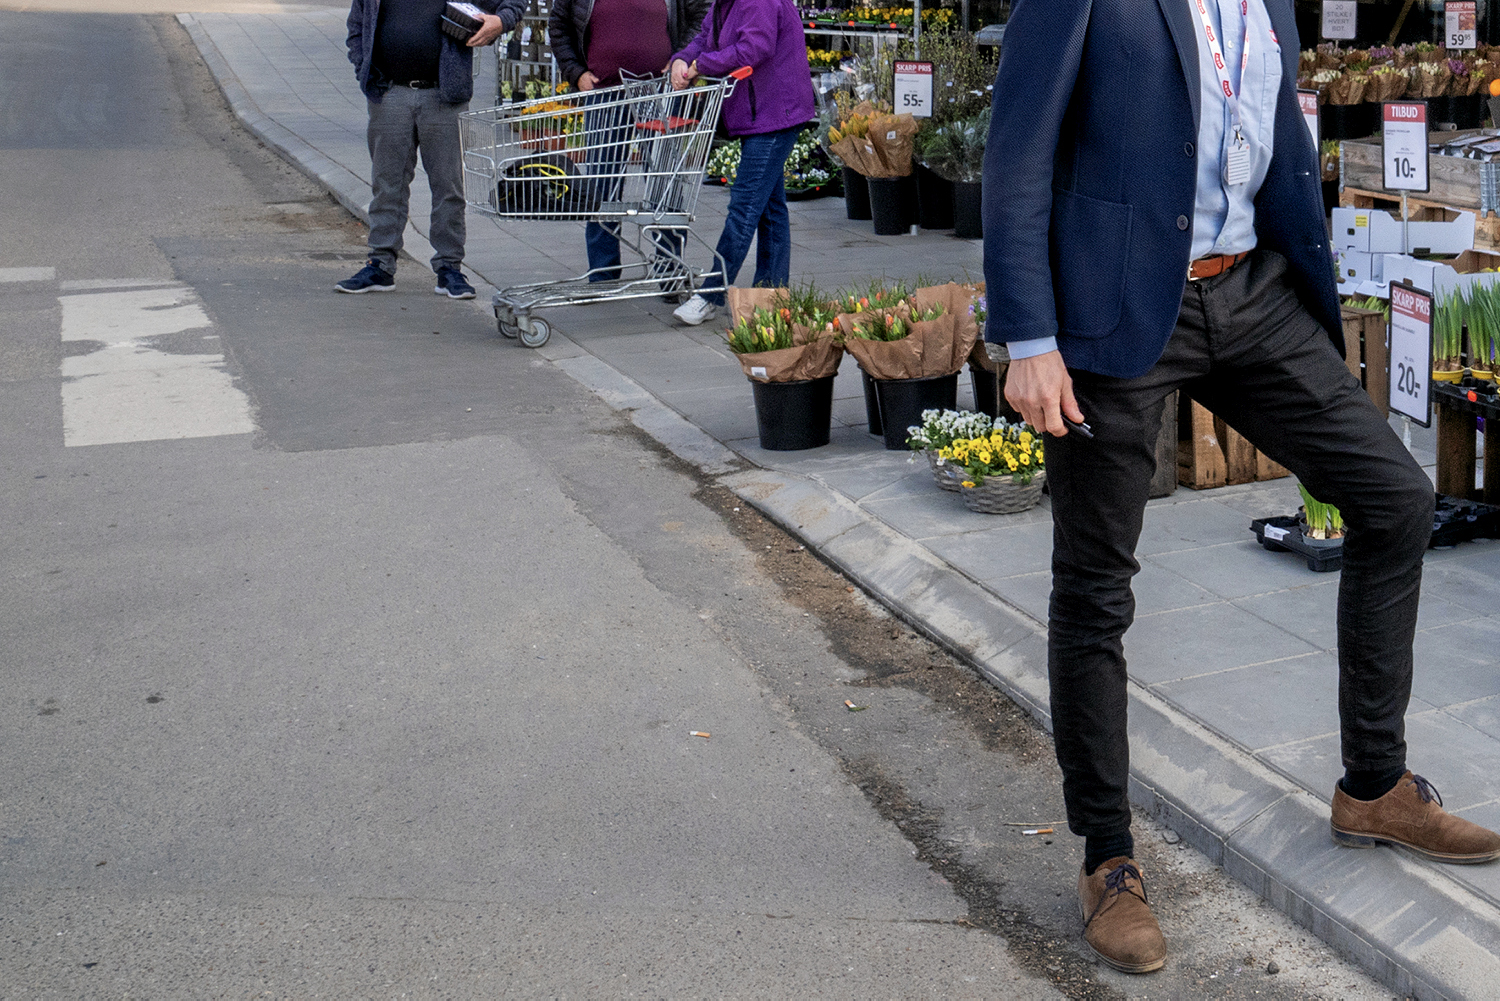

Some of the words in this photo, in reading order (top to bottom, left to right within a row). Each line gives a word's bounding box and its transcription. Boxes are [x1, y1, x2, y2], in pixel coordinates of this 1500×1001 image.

[1391, 106, 1418, 118] TILBUD
[1393, 290, 1414, 309] SKARP
[1415, 298, 1430, 316] PRIS
